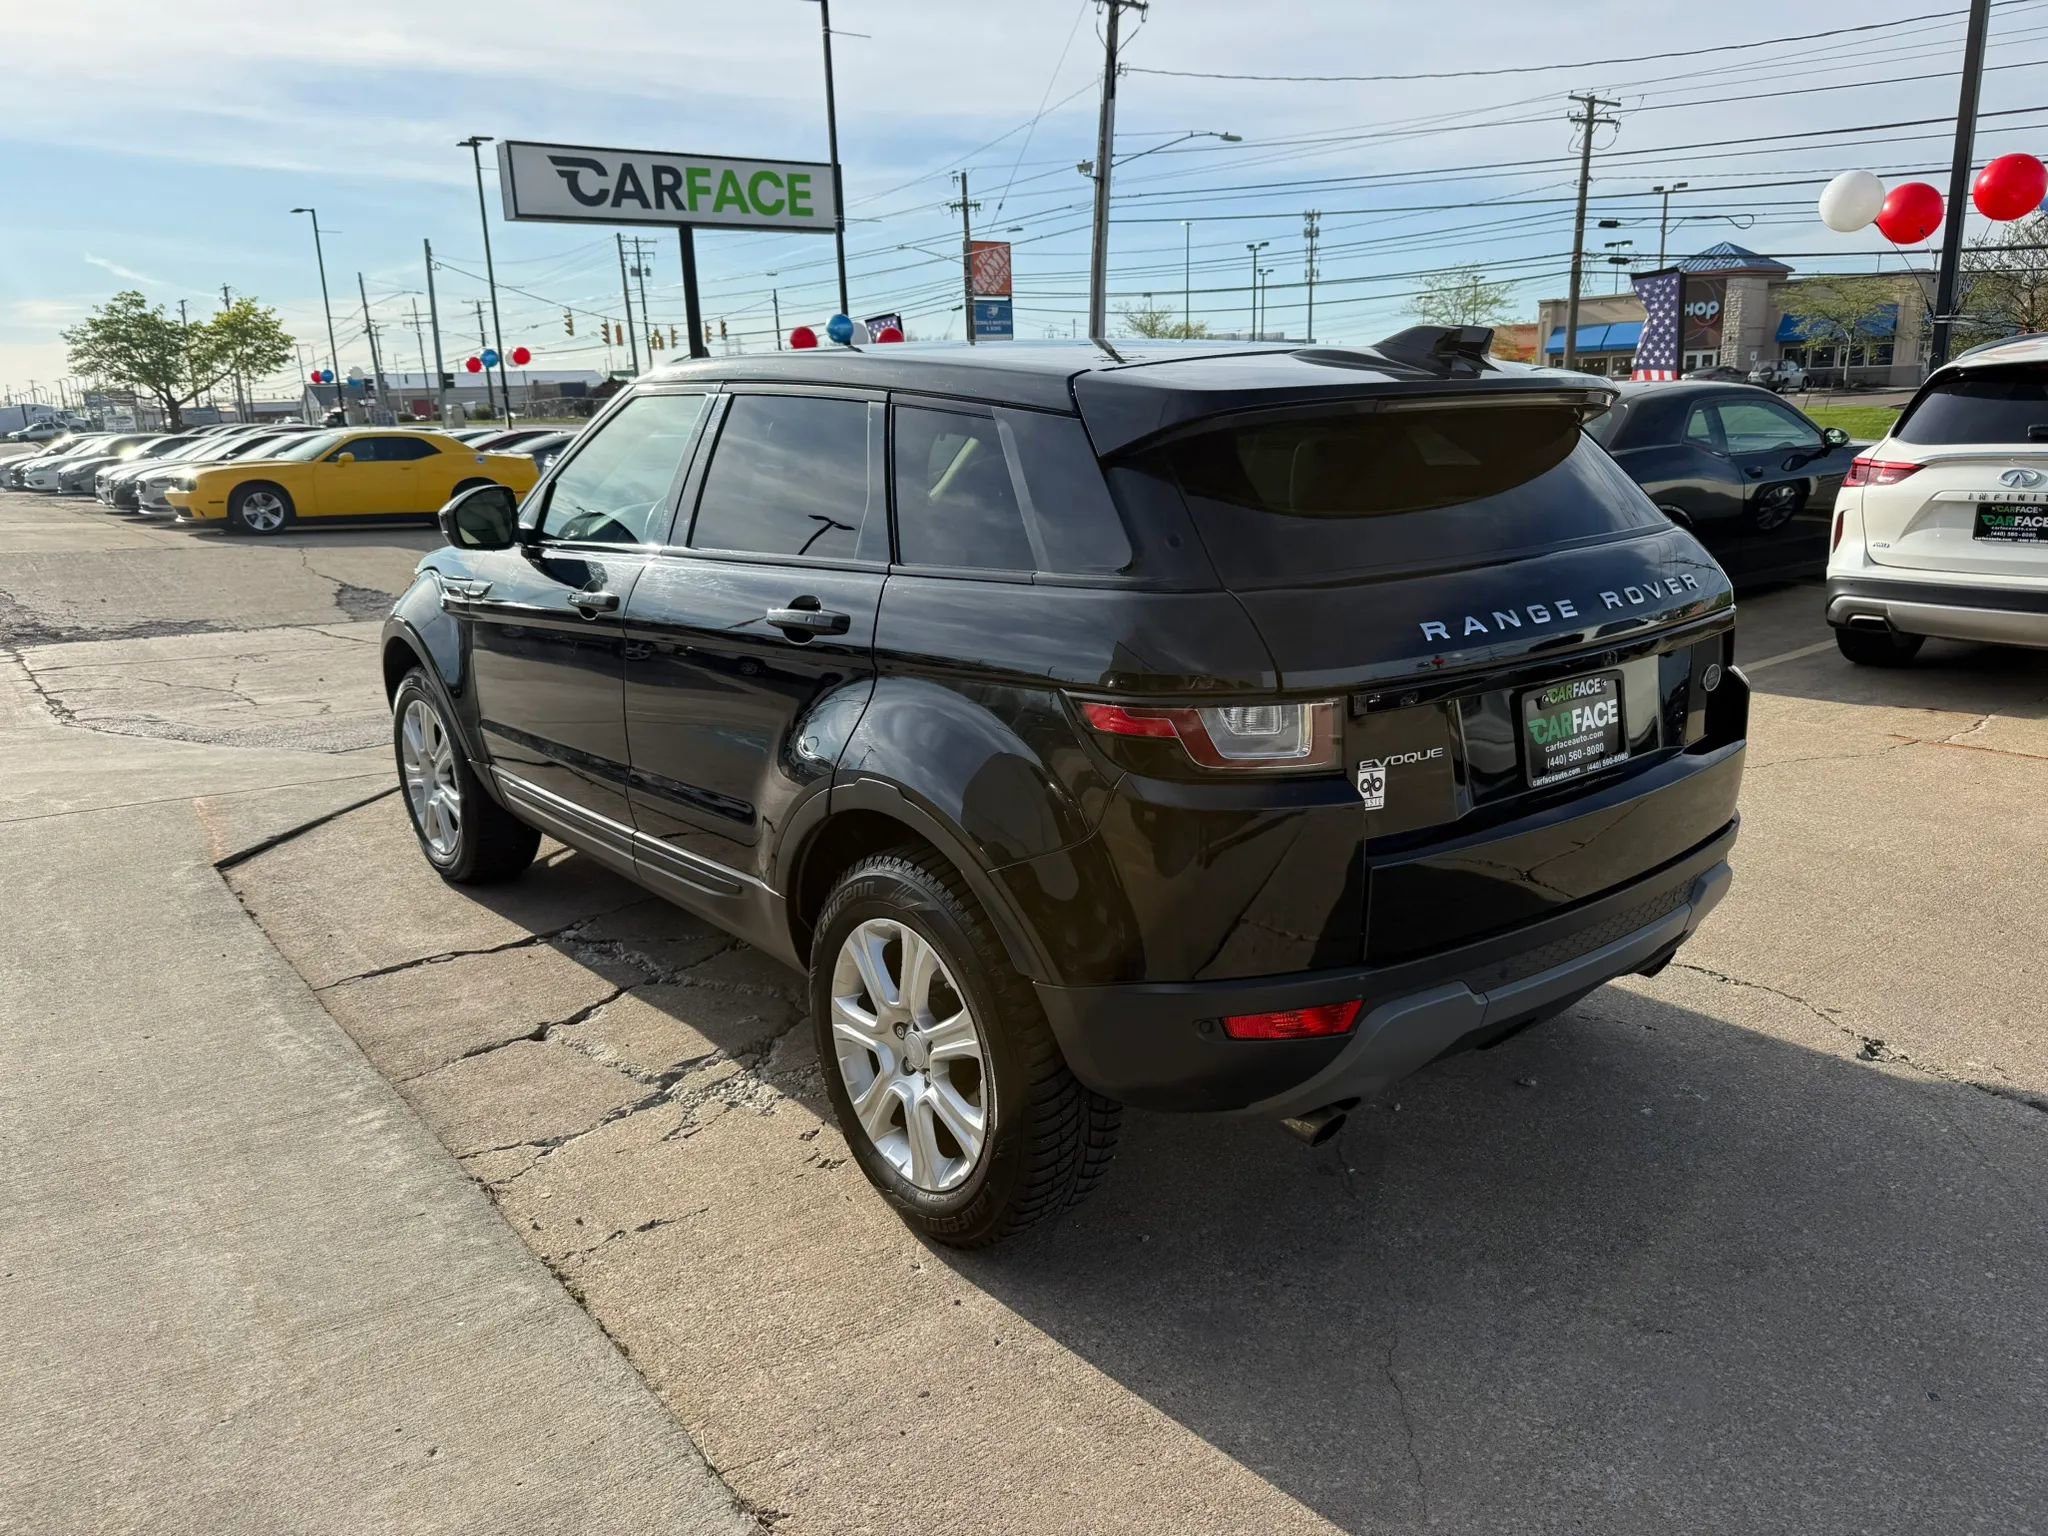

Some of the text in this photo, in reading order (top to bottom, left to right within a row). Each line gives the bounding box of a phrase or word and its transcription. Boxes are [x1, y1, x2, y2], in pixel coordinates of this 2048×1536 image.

[546, 155, 814, 217] CARFACE
[1684, 301, 1720, 320] HOP
[1981, 514, 2048, 527] CARFACE
[1995, 505, 2039, 513] CARFACE
[1419, 573, 1700, 642] RANGE ROVER
[1547, 678, 1601, 704] CARFACE
[1528, 699, 1618, 745] CARFACE
[1545, 730, 1604, 753] carfaceauto.com
[1359, 747, 1444, 769] EVOQUE
[1547, 742, 1605, 769] (440) 560-8080
